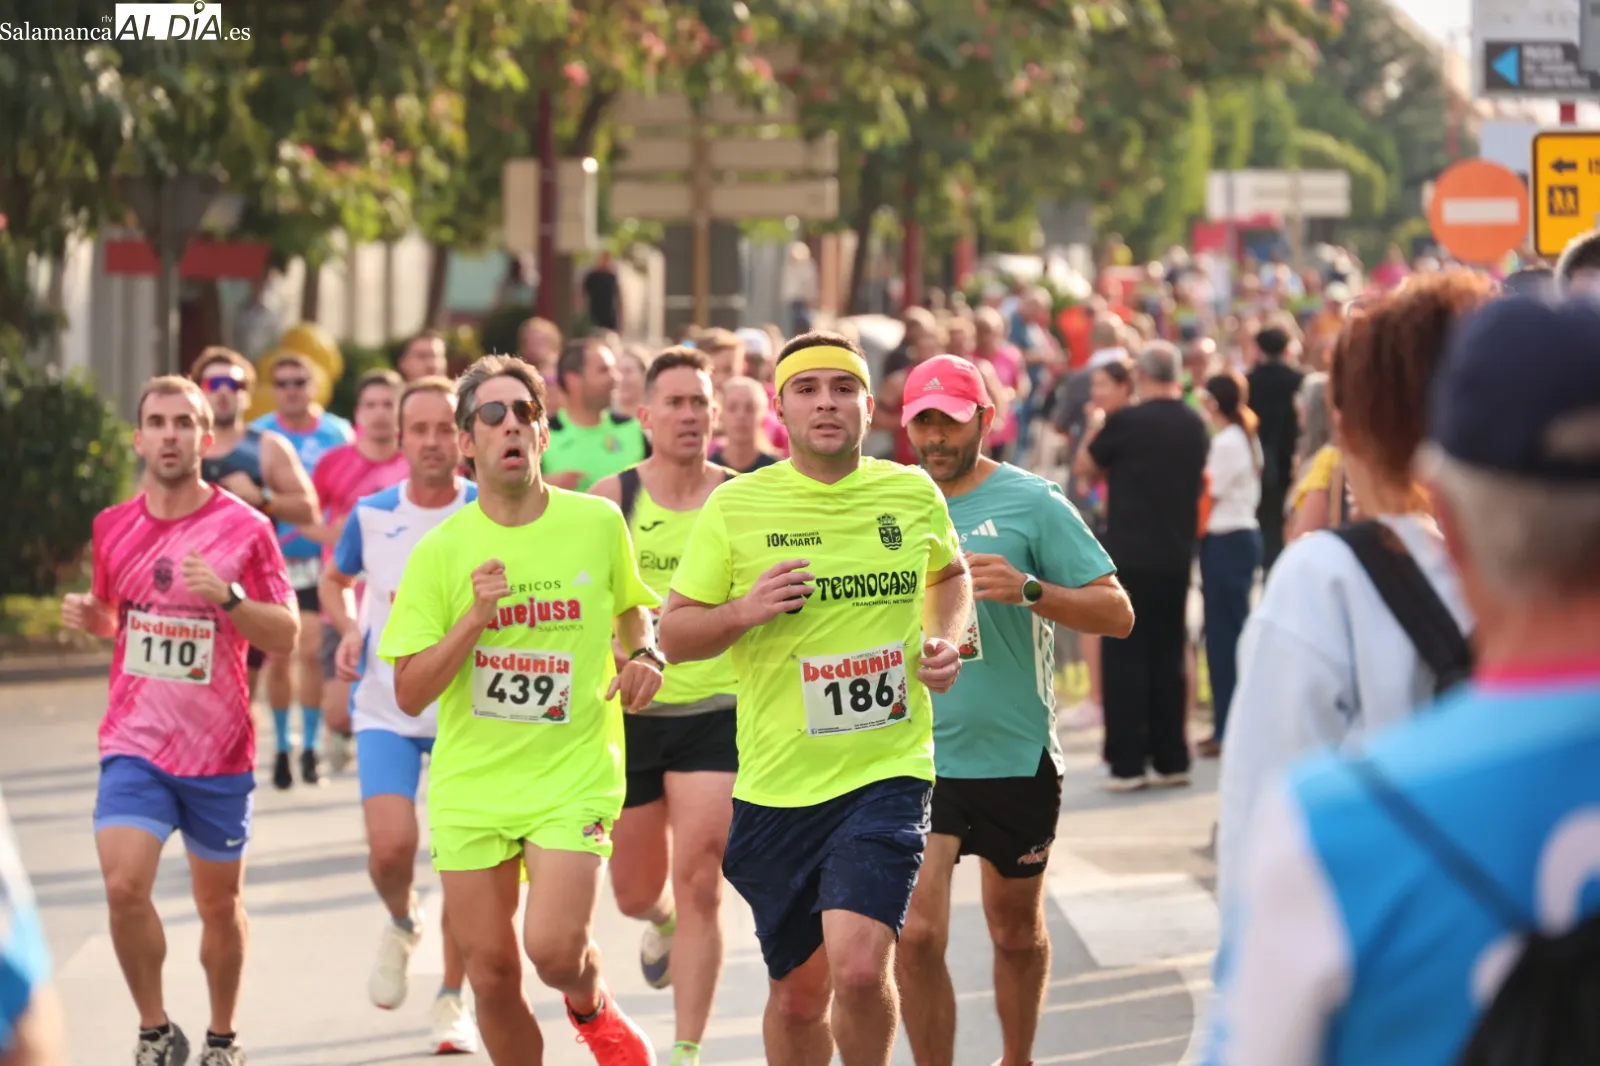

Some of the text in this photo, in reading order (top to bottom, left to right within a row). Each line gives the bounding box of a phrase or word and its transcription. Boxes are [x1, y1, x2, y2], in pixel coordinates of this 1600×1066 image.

[766, 533, 789, 547] 10K
[789, 537, 822, 547] MARTA
[509, 579, 561, 594] ERICOS
[816, 570, 917, 602] TECNOCASA
[130, 615, 211, 639] bedunia
[141, 636, 197, 667] 110
[475, 650, 570, 674] bedunia
[803, 649, 903, 682] bedunia
[486, 672, 554, 706] 439
[824, 671, 895, 716] 186
